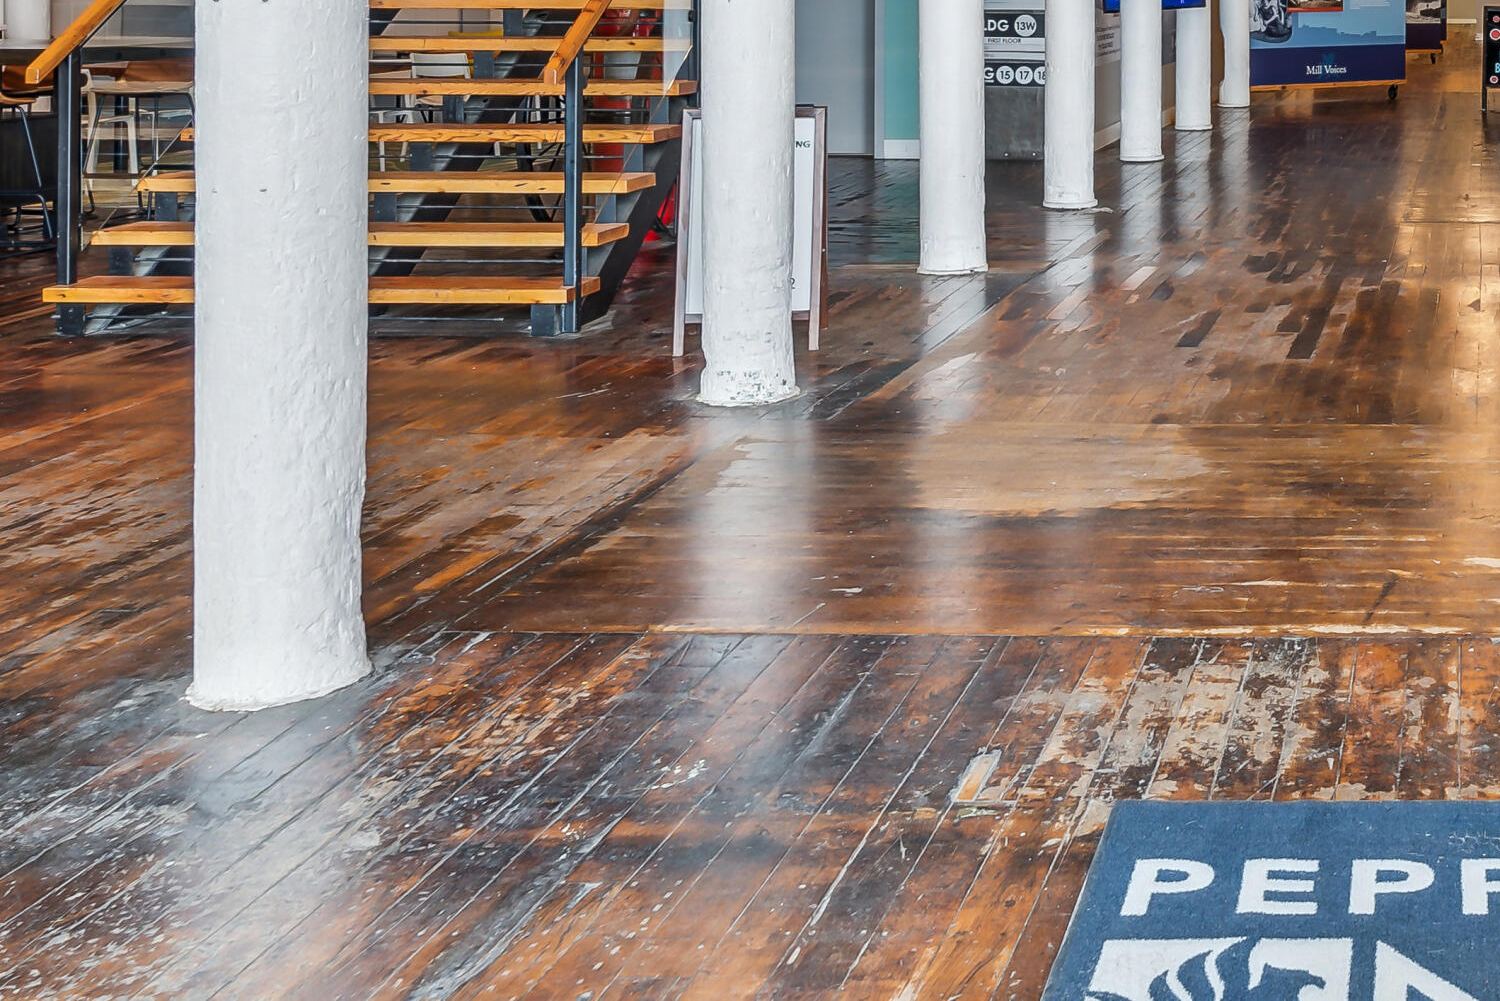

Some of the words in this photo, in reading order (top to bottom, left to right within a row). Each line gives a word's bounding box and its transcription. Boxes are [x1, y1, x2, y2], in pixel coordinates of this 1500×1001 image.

[1015, 20, 1037, 31] 13W
[999, 70, 1011, 80] 15
[1019, 70, 1030, 80] 17
[1306, 64, 1322, 75] Mill
[1324, 64, 1347, 75] Voices
